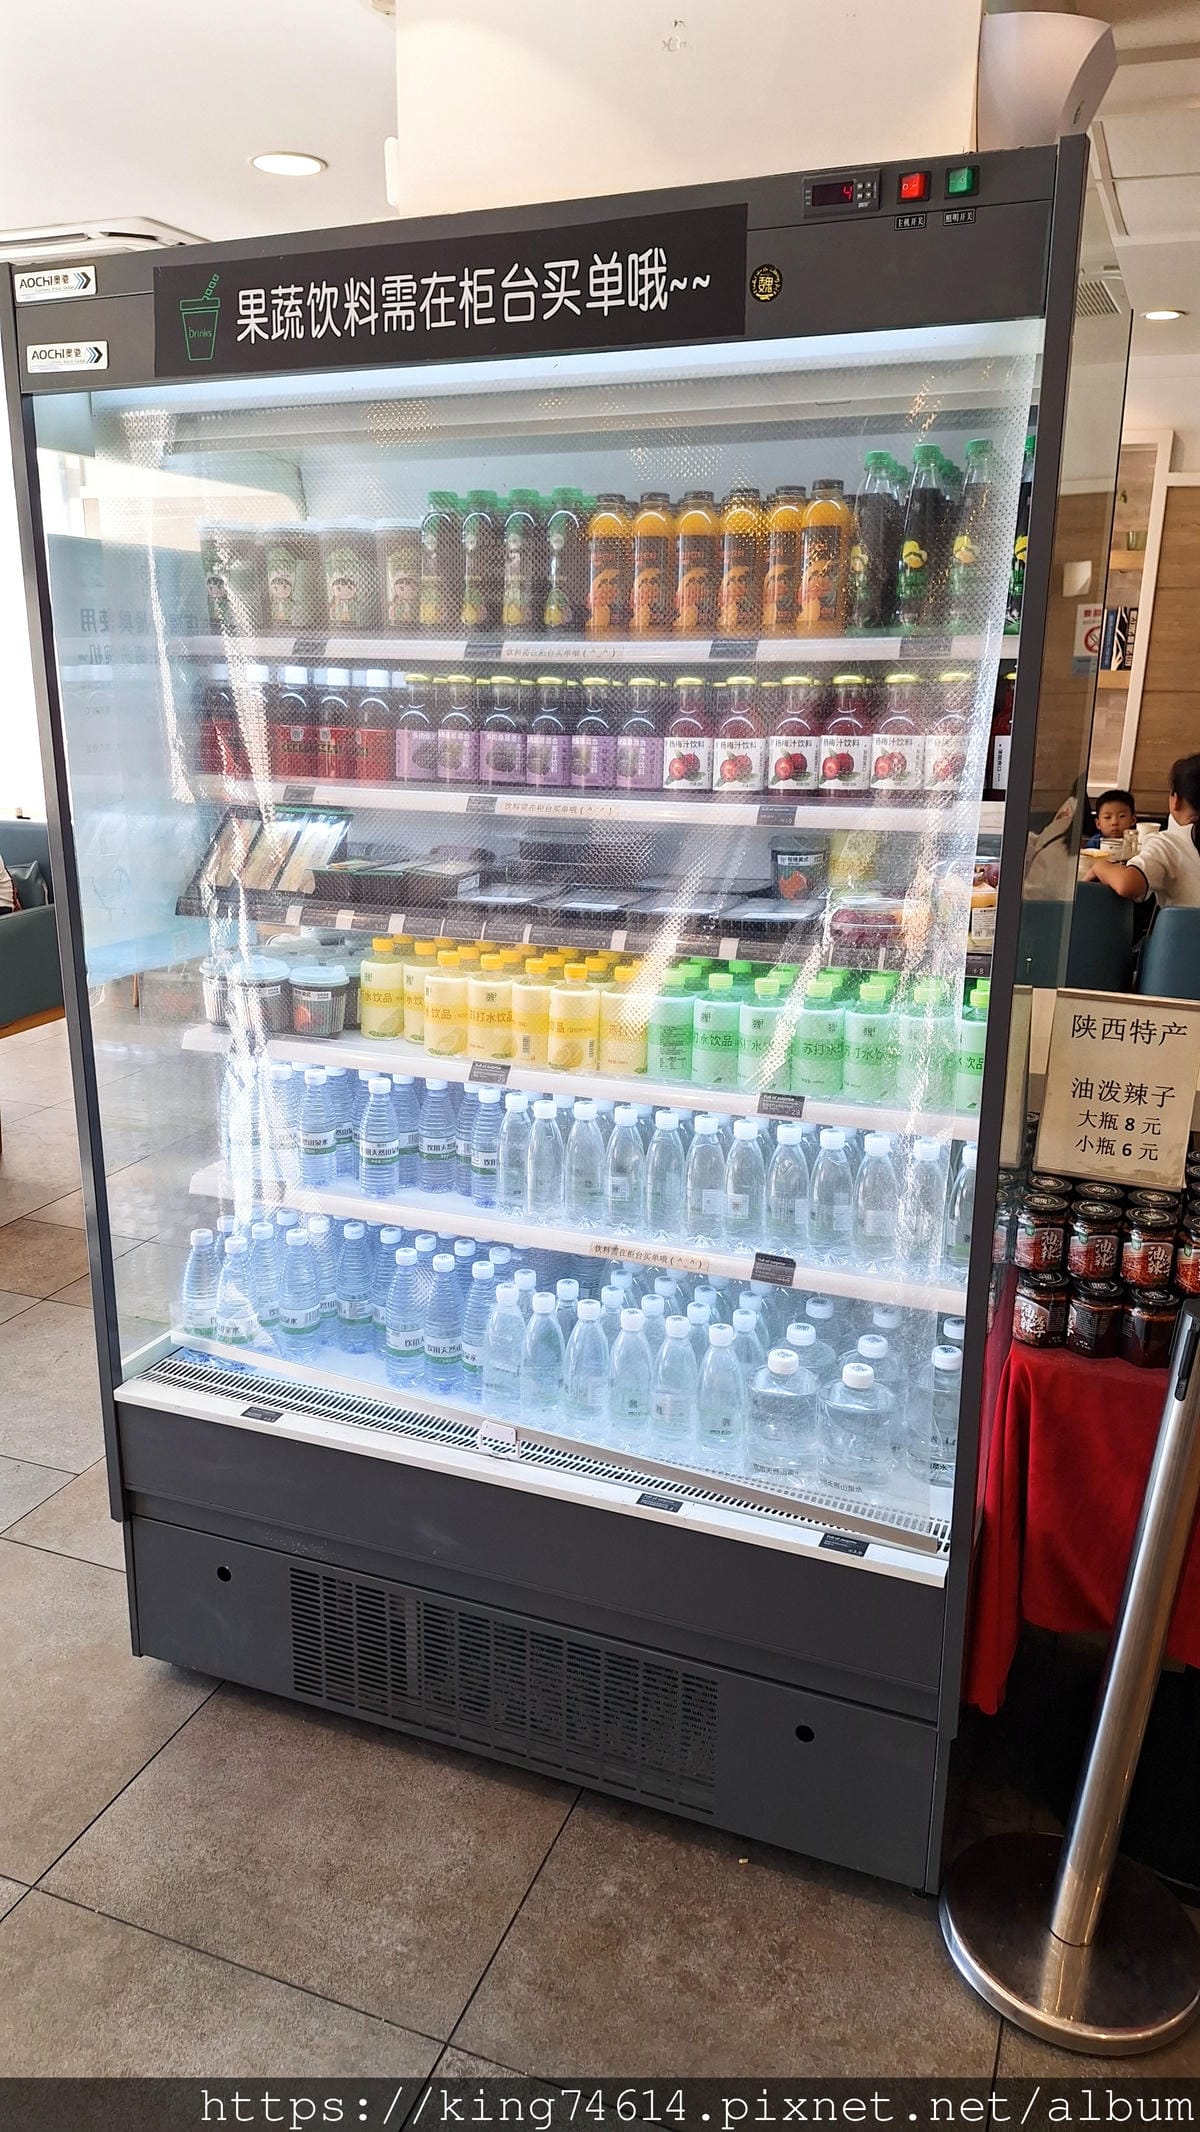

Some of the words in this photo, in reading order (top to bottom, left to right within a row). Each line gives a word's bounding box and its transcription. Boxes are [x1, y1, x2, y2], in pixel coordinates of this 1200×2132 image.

[842, 184, 853, 202] 4
[188, 326, 213, 339] Drinks
[1071, 1013, 1189, 1047] 陕西特产
[1070, 1076, 1177, 1109] 油泼辣子
[1077, 1109, 1119, 1131] 大瓶
[1124, 1116, 1135, 1132] 8
[1141, 1116, 1162, 1136] 元
[1074, 1134, 1116, 1157] 小瓶
[1121, 1143, 1133, 1158] 6
[1137, 1141, 1159, 1161] 元
